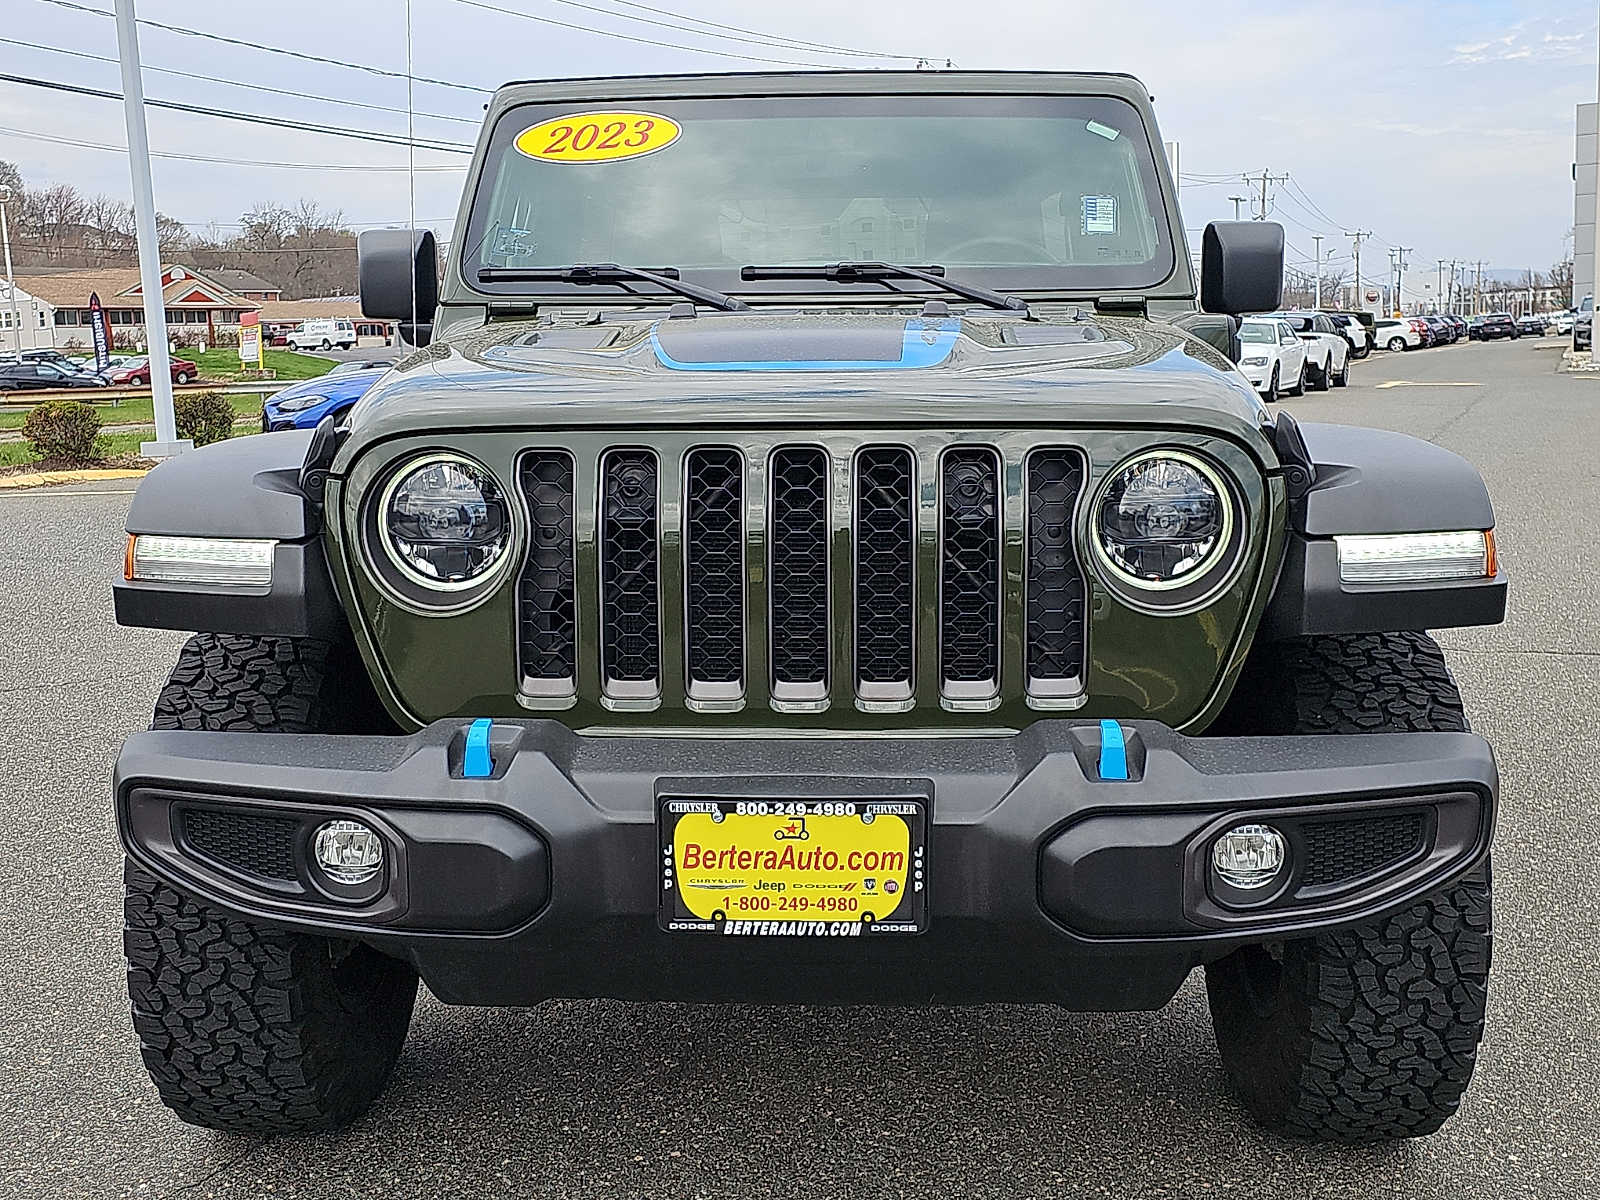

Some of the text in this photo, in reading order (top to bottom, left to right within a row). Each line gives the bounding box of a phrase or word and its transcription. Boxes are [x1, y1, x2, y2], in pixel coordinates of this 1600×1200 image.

[543, 120, 654, 153] 2023
[92, 311, 108, 368] MITSUBISHI
[669, 802, 719, 813] CHRYSLER
[736, 802, 856, 816] 800-249-4980
[867, 804, 917, 815] CHRYSLER
[683, 844, 903, 870] BerteraAuto.com
[664, 844, 673, 890] Jeep
[914, 846, 923, 892] Jeep
[753, 879, 786, 892] Jeep
[722, 896, 858, 912] 1-800-249-4980
[724, 921, 862, 937] BERTERAAUTO.COM
